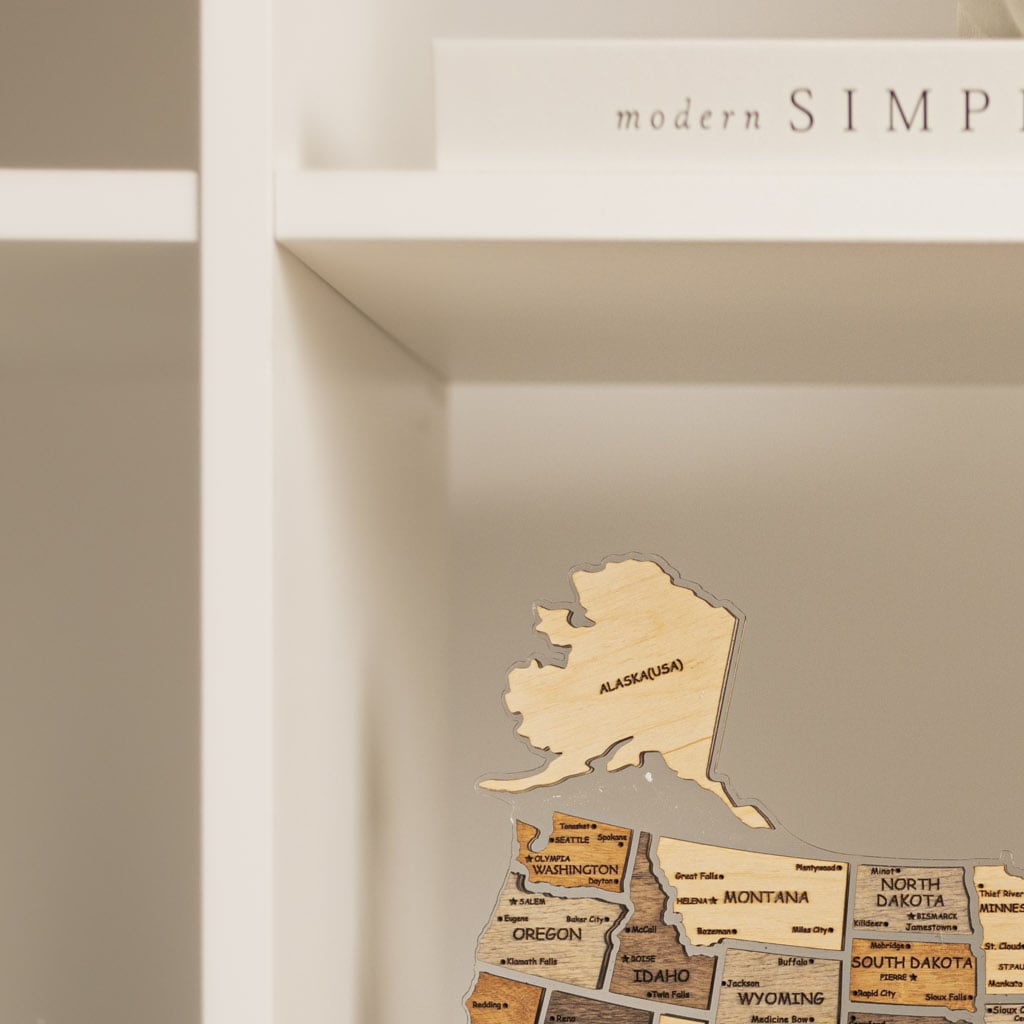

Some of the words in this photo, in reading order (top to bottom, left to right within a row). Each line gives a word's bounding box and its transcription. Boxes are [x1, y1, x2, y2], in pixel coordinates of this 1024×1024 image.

[616, 97, 760, 130] modern
[600, 659, 683, 694] ALASKA(USA)
[555, 836, 589, 844] SEATTLE
[533, 865, 618, 875] WASHINGTON
[589, 878, 614, 886] Dayton
[881, 878, 940, 891] NORTH
[724, 891, 809, 904] MONTANA
[877, 895, 944, 907] DAKOTA
[504, 915, 528, 923] Eugene
[513, 928, 582, 941] OREGON
[778, 958, 807, 966] Buffalo
[852, 956, 905, 969] SOUTH
[911, 958, 972, 969] DAKOTA
[634, 970, 689, 983] IDAHO
[739, 992, 824, 1005] WYOMING
[880, 990, 896, 998] City
[472, 1002, 500, 1010] Redding
[993, 1007, 1017, 1015] Sioux
